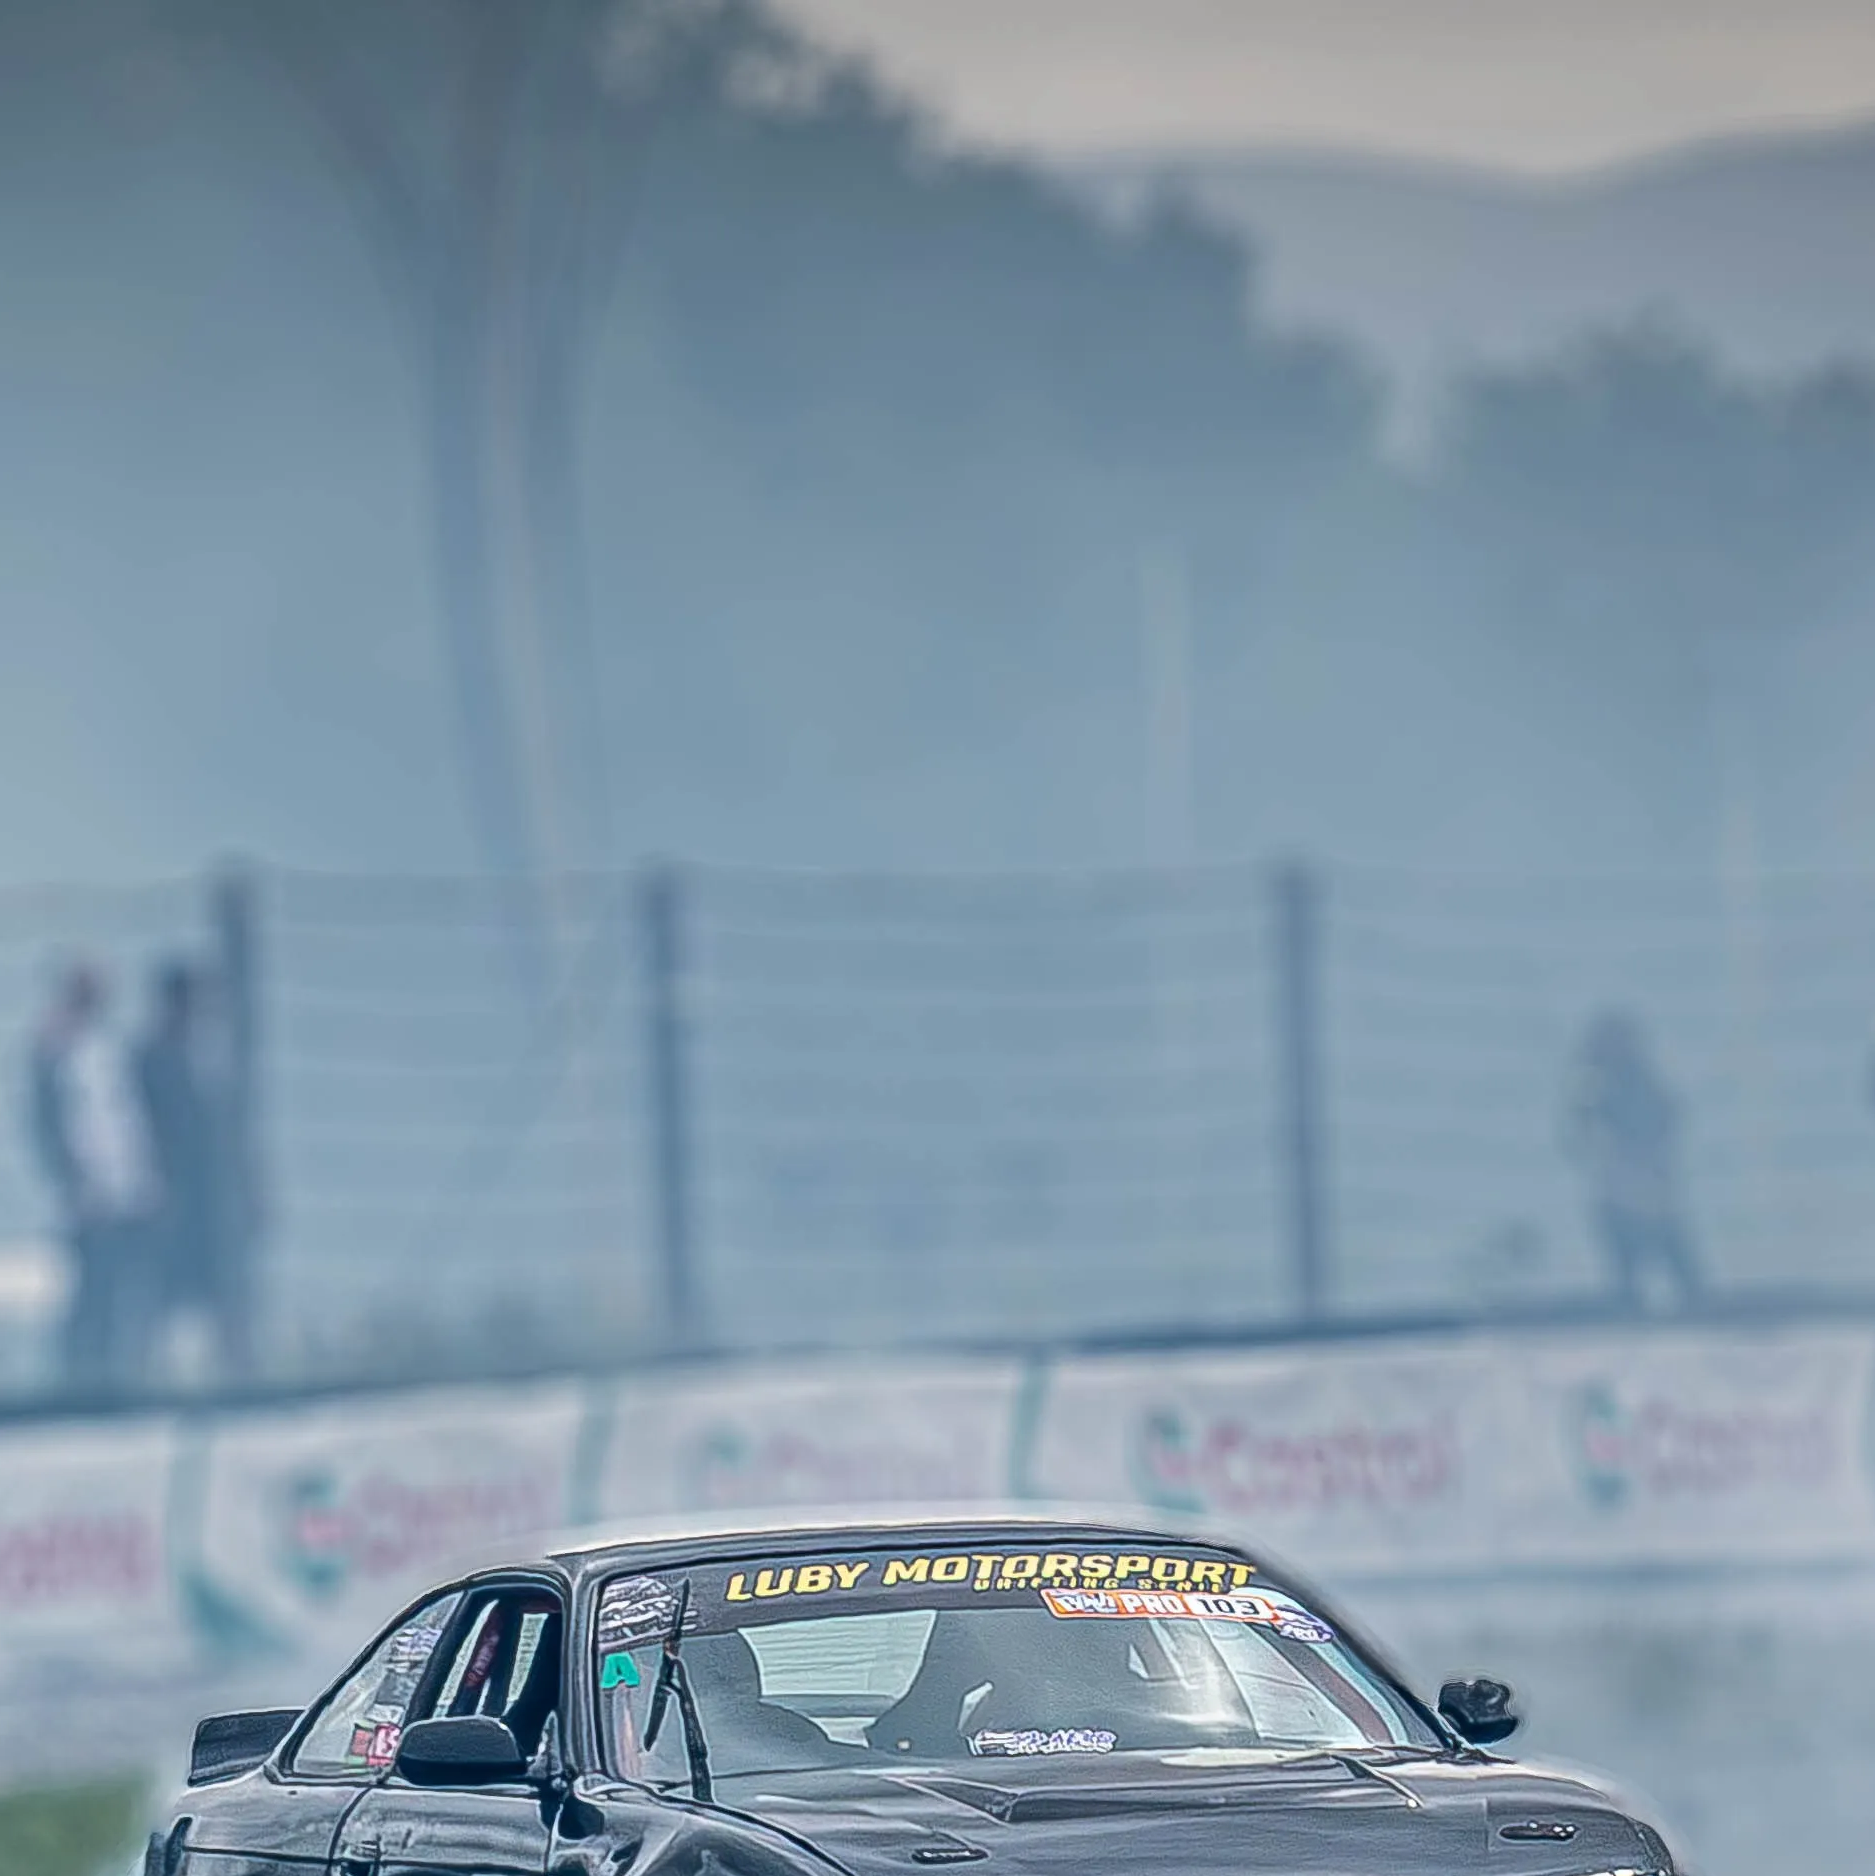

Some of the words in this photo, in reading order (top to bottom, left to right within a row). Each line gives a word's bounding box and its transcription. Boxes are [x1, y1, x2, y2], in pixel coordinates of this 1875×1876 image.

[726, 1562, 869, 1600] LUBY
[882, 1553, 1257, 1585] MOTORSPORT
[1196, 1597, 1260, 1615] 103
